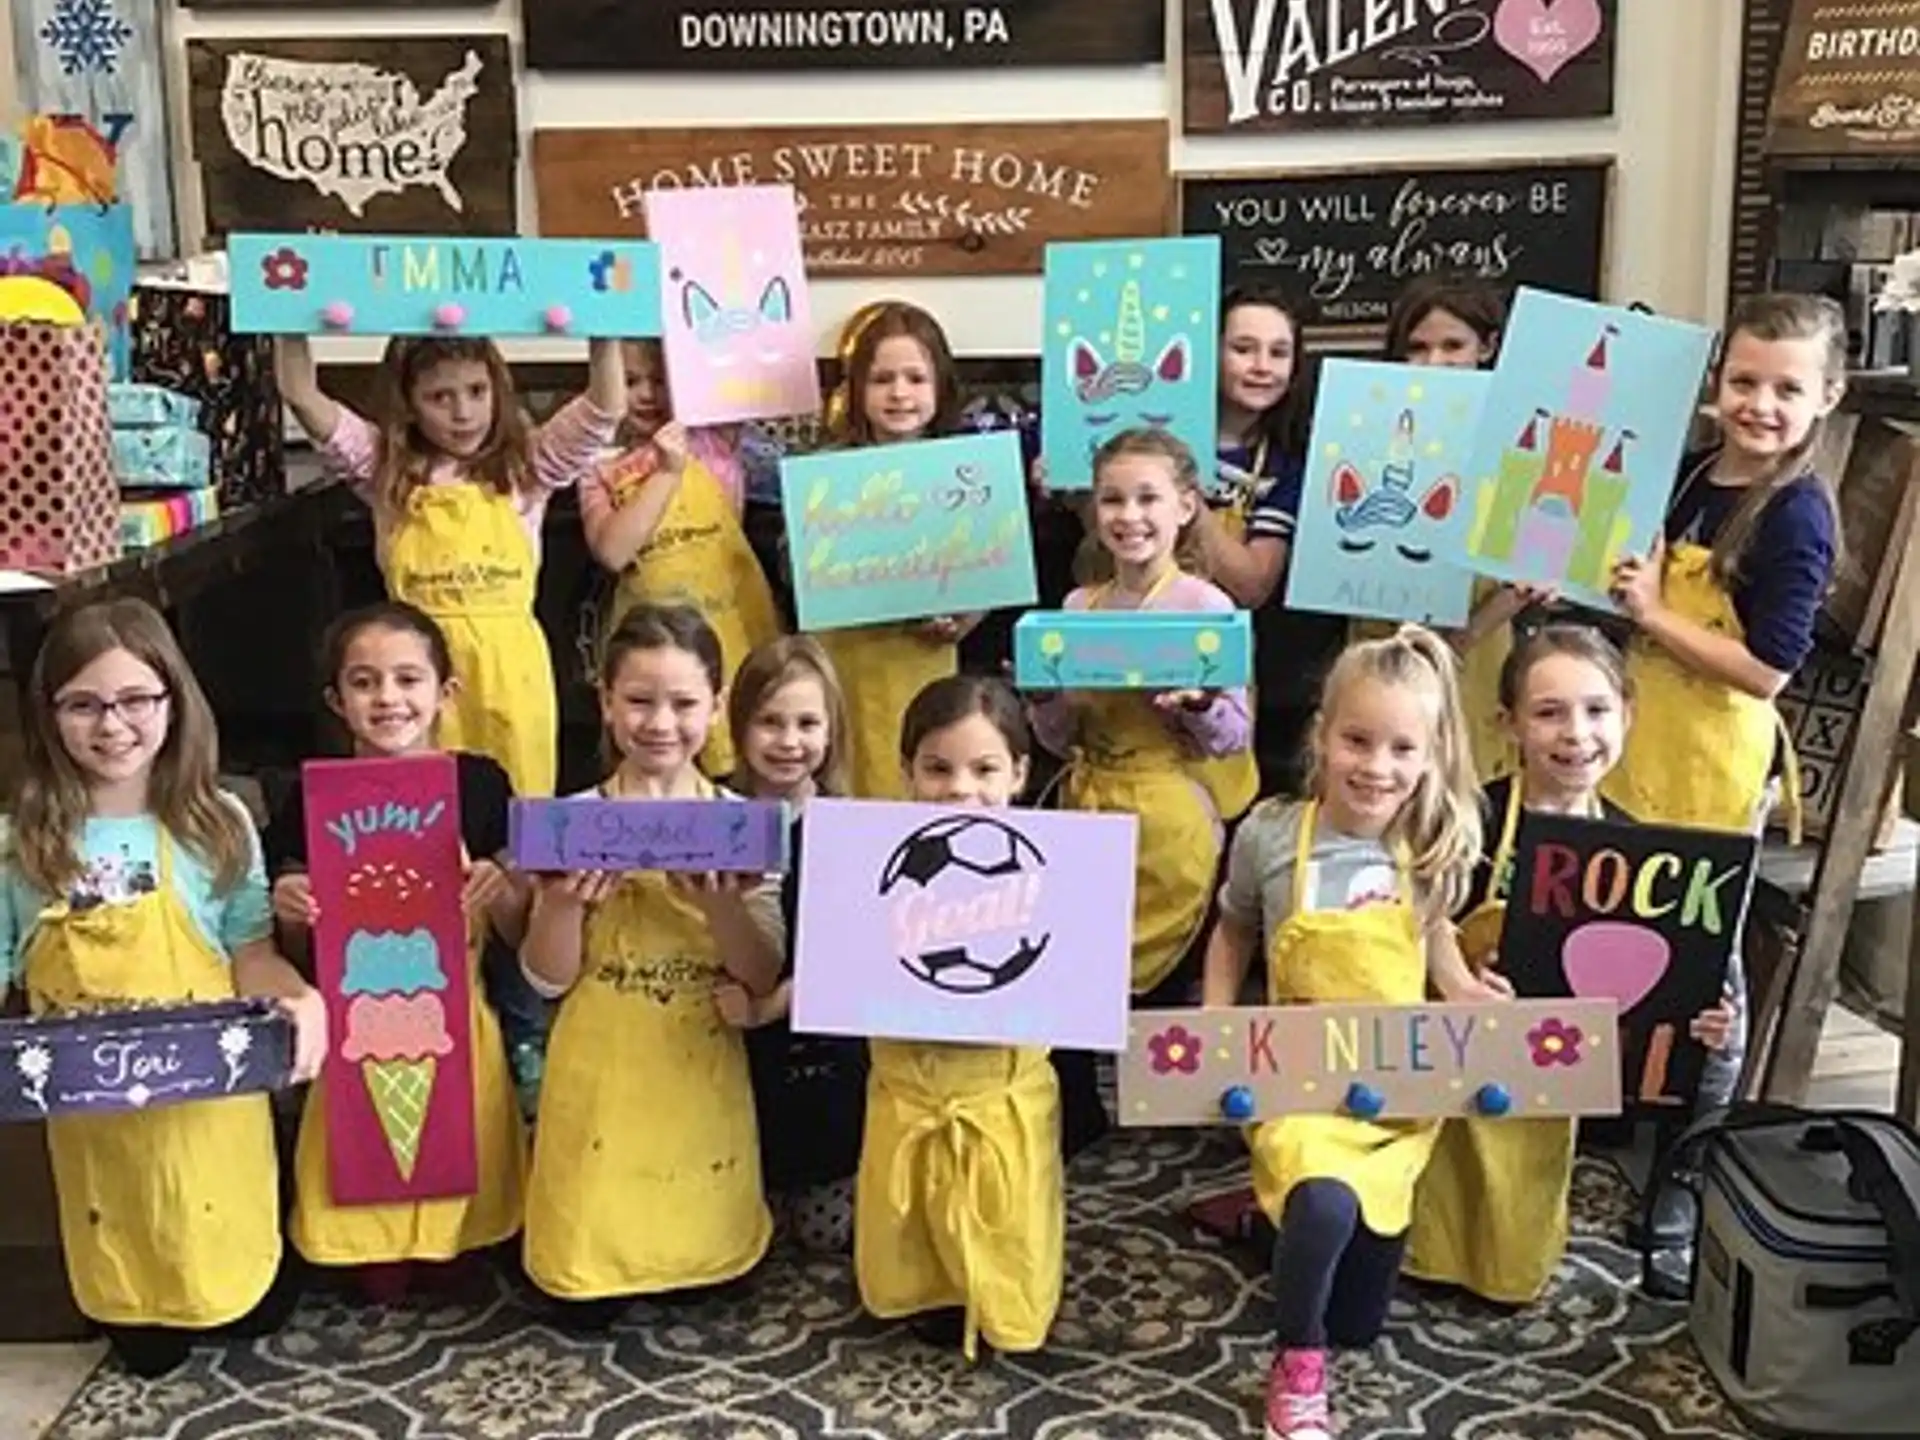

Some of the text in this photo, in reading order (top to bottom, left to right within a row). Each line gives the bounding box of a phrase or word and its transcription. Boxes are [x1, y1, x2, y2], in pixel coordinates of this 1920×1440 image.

[681, 11, 1009, 51] DOWNINGTOWN, PA
[1267, 80, 1321, 114] CO.
[772, 144, 932, 184] SWEET
[951, 148, 1099, 208] HOME
[1216, 200, 1287, 227] YOU
[1302, 195, 1376, 223] WILL
[1530, 182, 1568, 214] BE
[1532, 843, 1742, 934] ROCK
[92, 1040, 182, 1088] Tori
